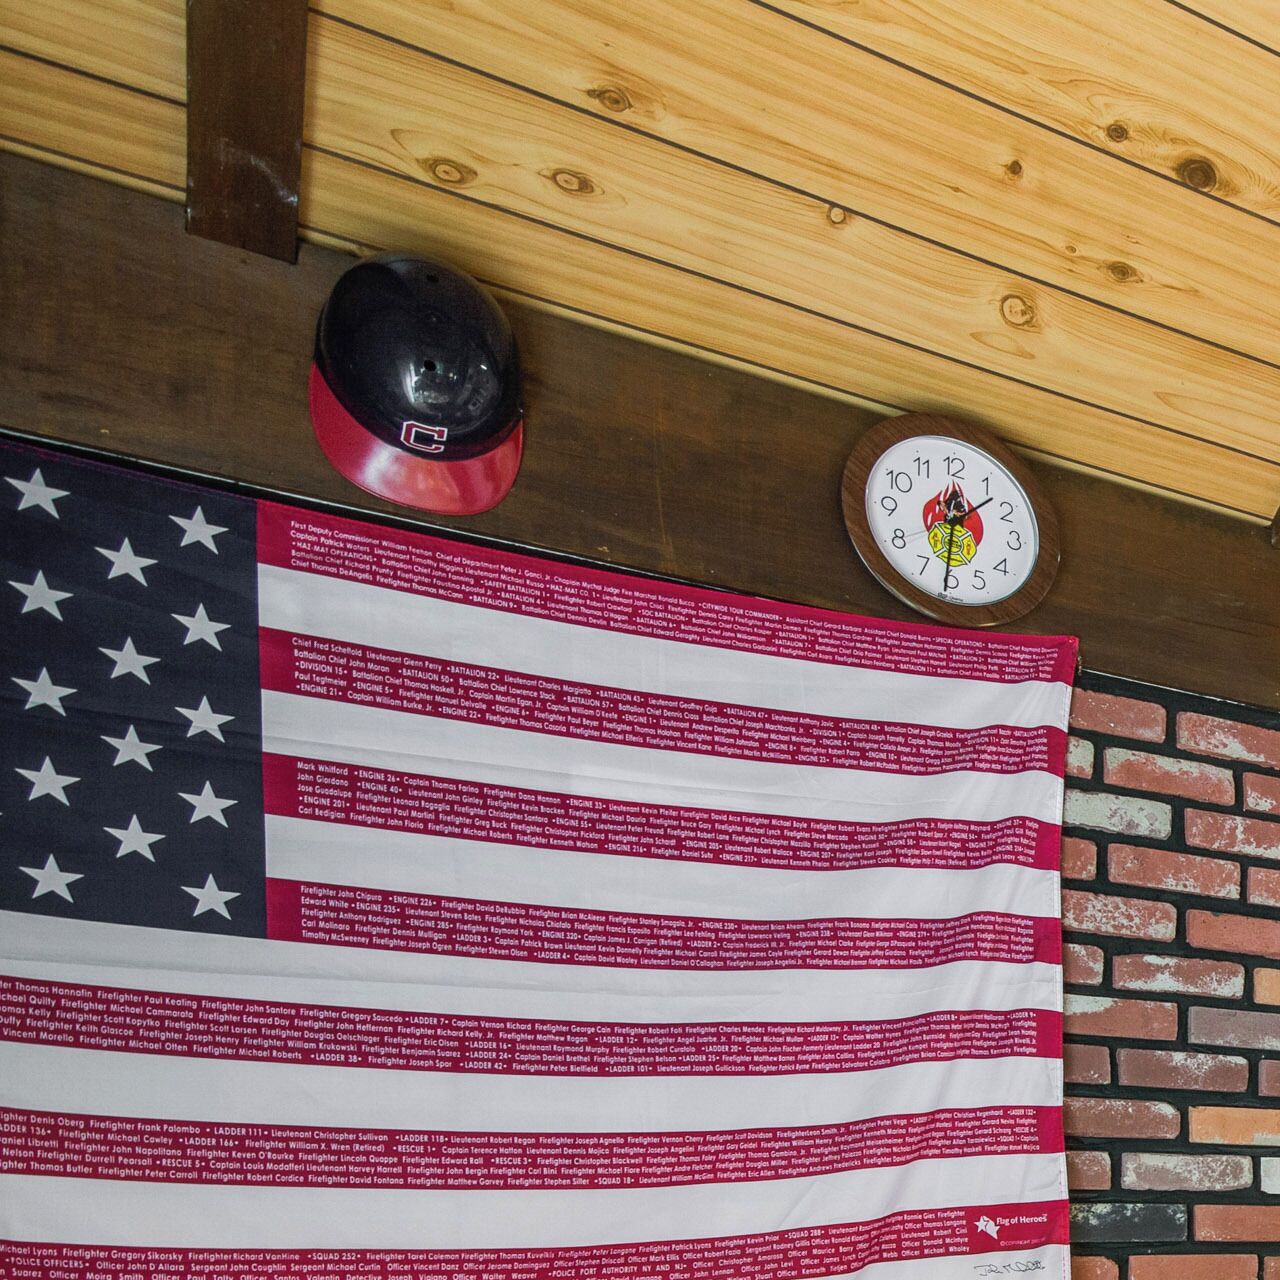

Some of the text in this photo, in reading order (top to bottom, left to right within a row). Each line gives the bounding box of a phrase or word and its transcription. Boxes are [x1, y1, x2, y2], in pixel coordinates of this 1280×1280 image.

[401, 420, 447, 453] C
[913, 457, 930, 478] 11
[943, 456, 965, 480] 12
[886, 470, 912, 492] 10
[982, 477, 989, 496] 1
[881, 496, 897, 516] 9
[1000, 502, 1014, 522] 2
[290, 530, 318, 542] Captain
[320, 536, 344, 548] Patrick
[291, 521, 307, 530] First
[308, 523, 332, 536] Deputy
[333, 530, 380, 546] Commissioner
[382, 539, 407, 551] William
[891, 528, 907, 549] 8
[1007, 531, 1021, 550] 3
[917, 555, 929, 575] 7
[993, 558, 1008, 576] 4
[945, 569, 959, 589] 6
[972, 570, 986, 589] 5
[15, 980, 50, 994] Thomas
[97, 990, 142, 1004] Firefighter
[144, 994, 163, 1005] Paul
[165, 997, 198, 1010] Keating
[997, 1216, 1047, 1226] Flag of Heroes
[33, 1247, 183, 1261] Lyons Firefighter Gregory Sikorsky
[12, 1268, 42, 1278] Suarez
[50, 1271, 79, 1279] Officer
[86, 1272, 112, 1280] Moira
[119, 1273, 144, 1280] Smith
